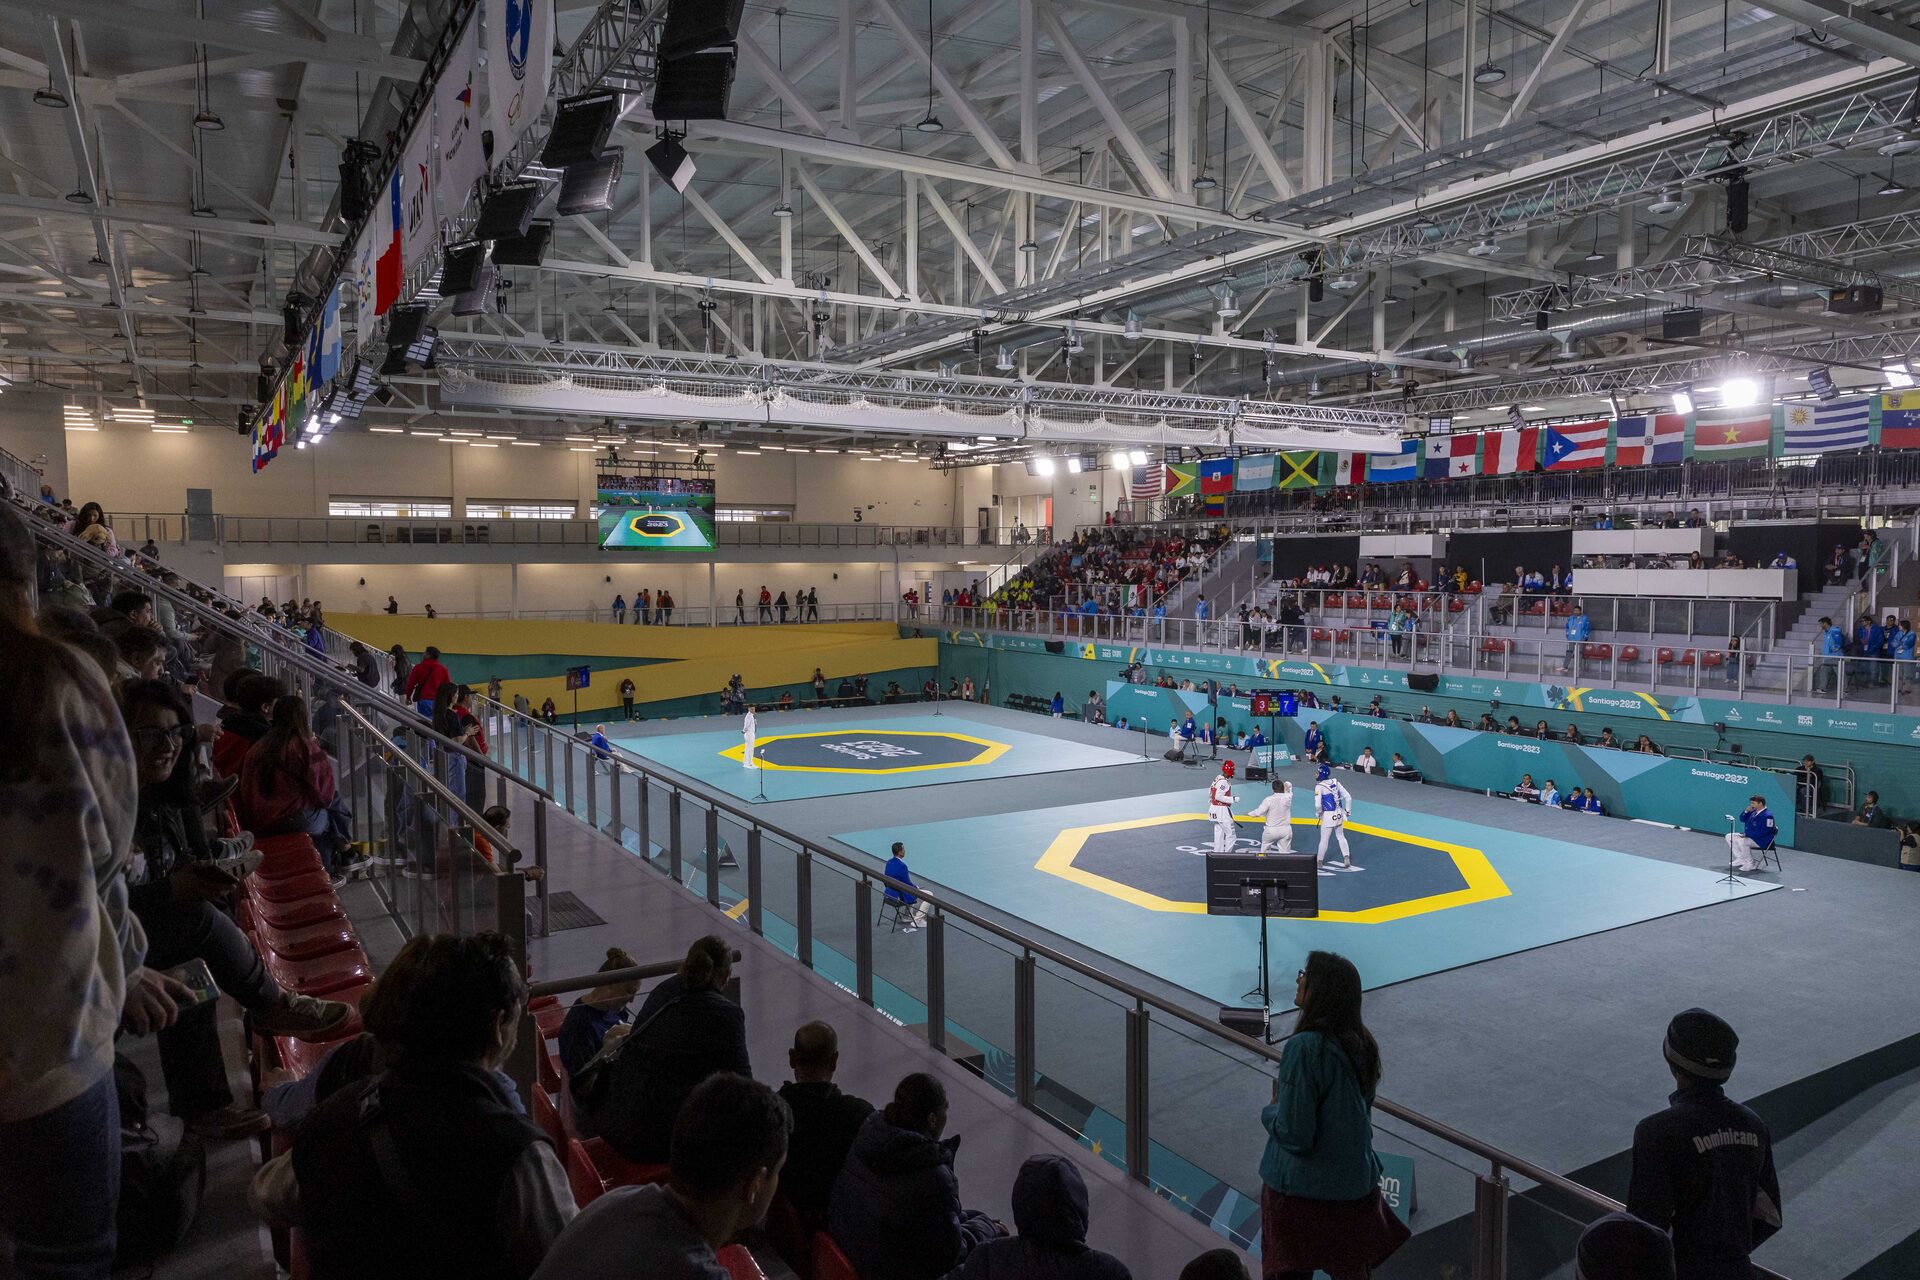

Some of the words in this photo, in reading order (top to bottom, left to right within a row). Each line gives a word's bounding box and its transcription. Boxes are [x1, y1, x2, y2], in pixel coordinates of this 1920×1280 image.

[854, 510, 862, 522] 3
[1259, 701, 1265, 709] 3
[1283, 701, 1289, 710] 7
[1588, 696, 1619, 706] Santiago
[1619, 699, 1641, 709] 2023
[1497, 740, 1523, 751] Santiago
[1522, 744, 1541, 754] 2023
[1691, 768, 1725, 781] Santiago
[1724, 773, 1748, 784] 2023
[1692, 1127, 1759, 1154] Dominicana
